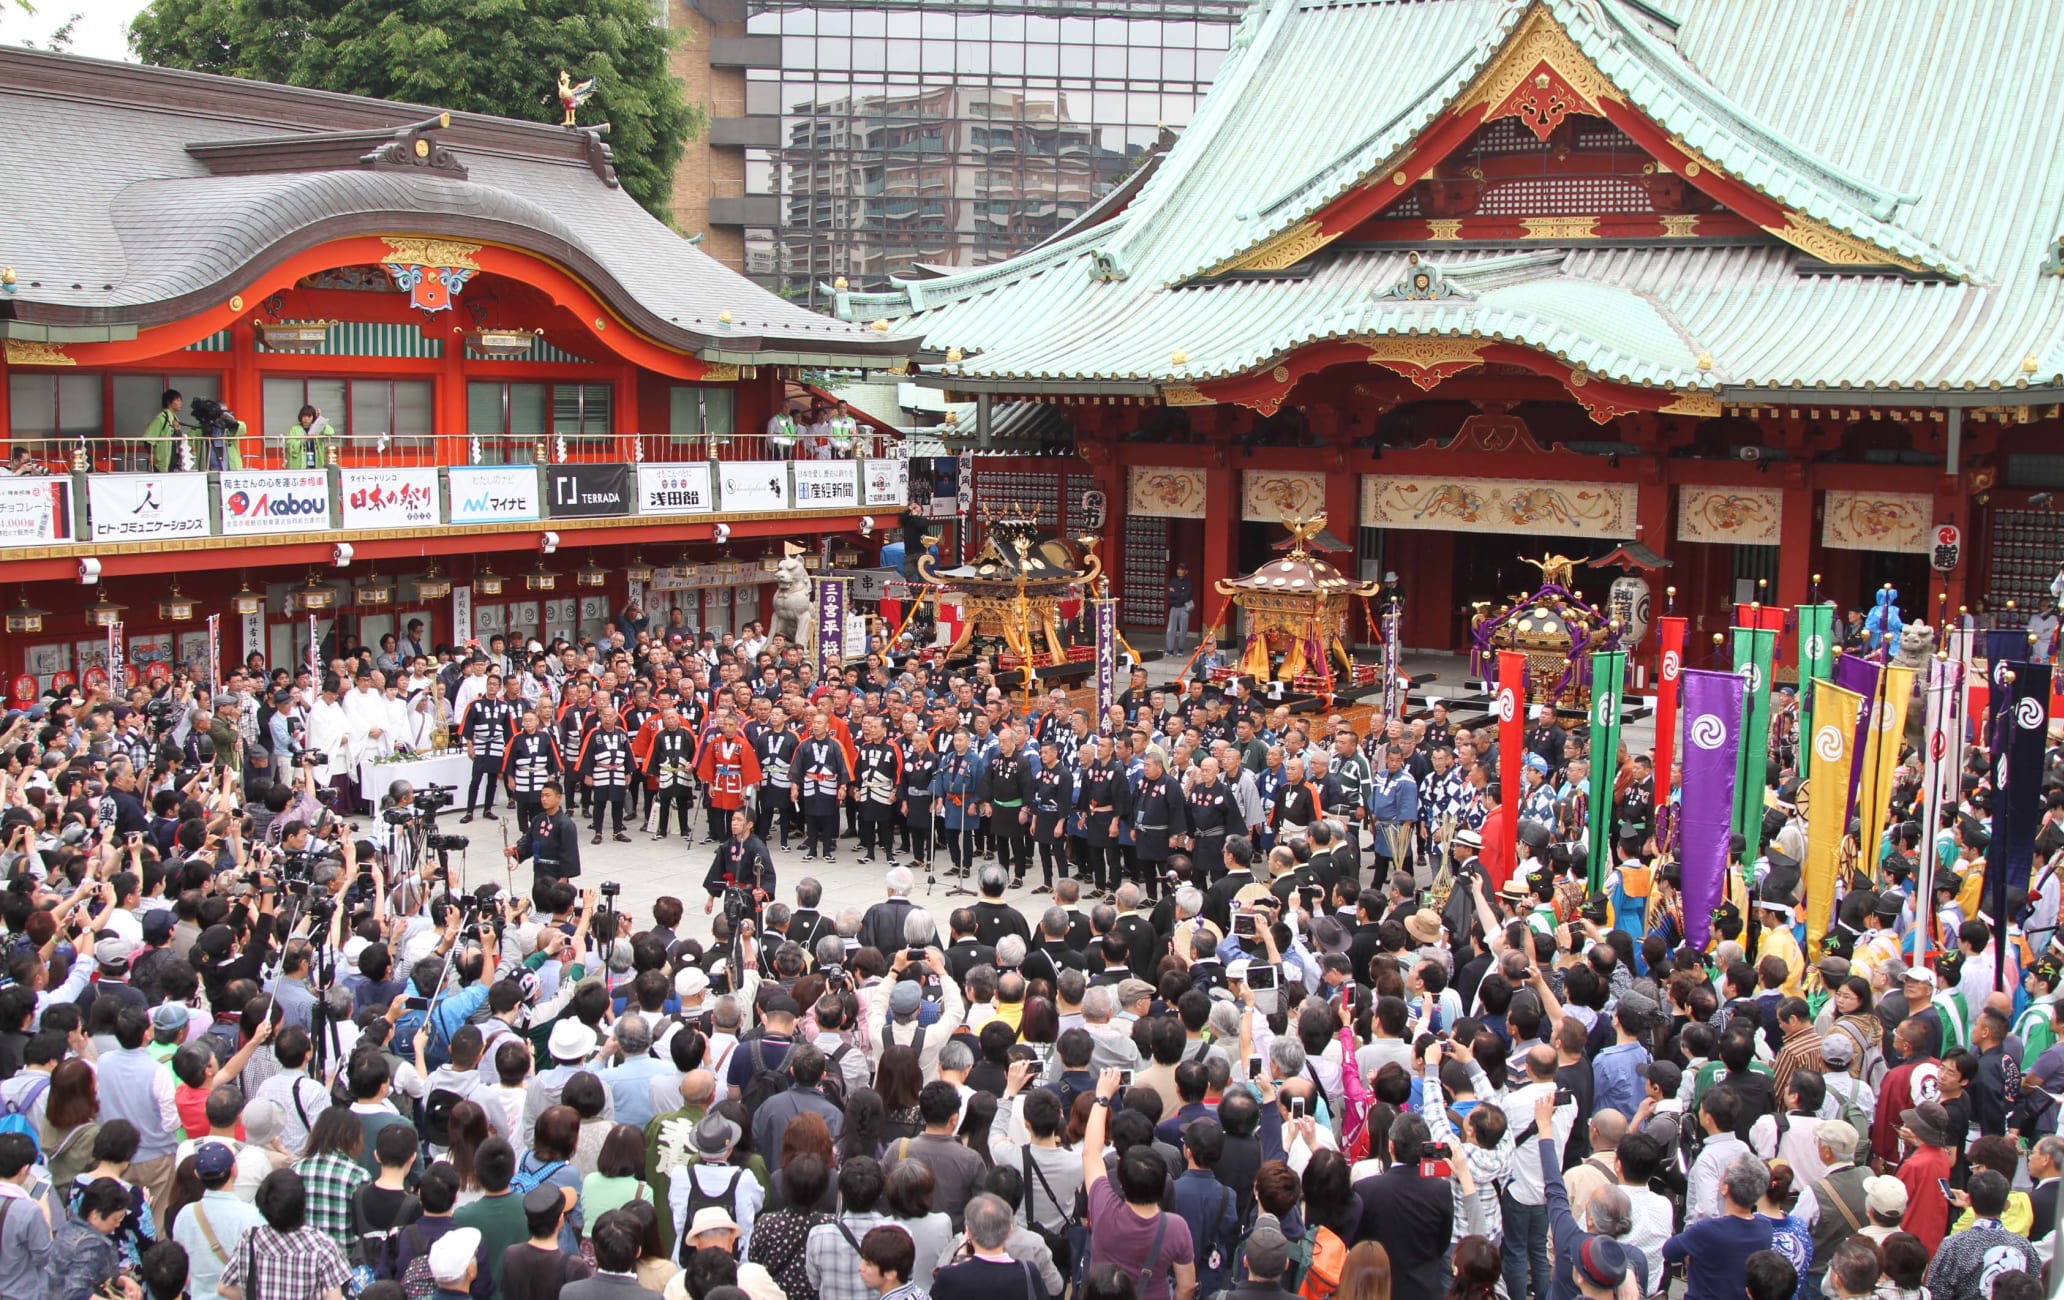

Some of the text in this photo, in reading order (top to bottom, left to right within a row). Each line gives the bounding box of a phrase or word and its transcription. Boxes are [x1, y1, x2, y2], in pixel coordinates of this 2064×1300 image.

[959, 458, 971, 503] 龍角散
[251, 492, 325, 517] Akabou
[350, 482, 431, 512] 日本の祭り
[490, 497, 526, 511] マイナビ
[581, 492, 620, 505] TERRADA
[650, 491, 699, 506] 浅田飴
[97, 518, 204, 535] ヒト・コミュニケーションズ
[821, 584, 841, 672] 三の宮平将
